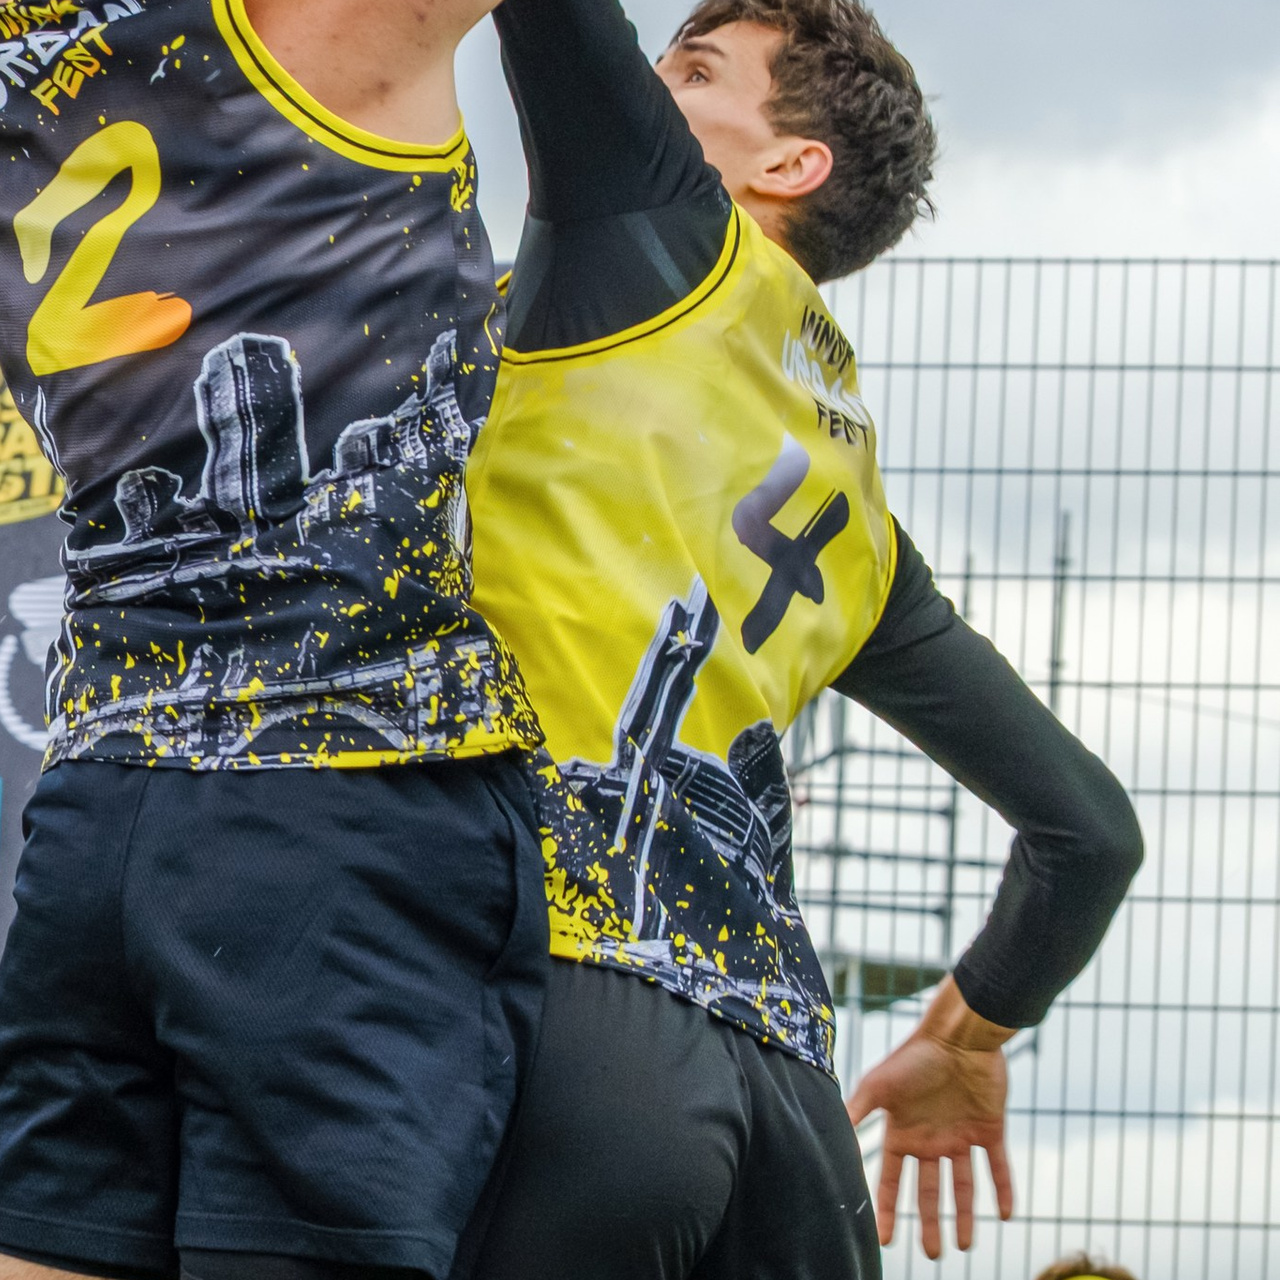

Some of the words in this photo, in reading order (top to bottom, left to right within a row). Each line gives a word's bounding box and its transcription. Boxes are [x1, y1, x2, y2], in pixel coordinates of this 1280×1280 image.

[30, 22, 113, 116] FEST
[14, 120, 193, 376] 2
[731, 431, 850, 655] 4
